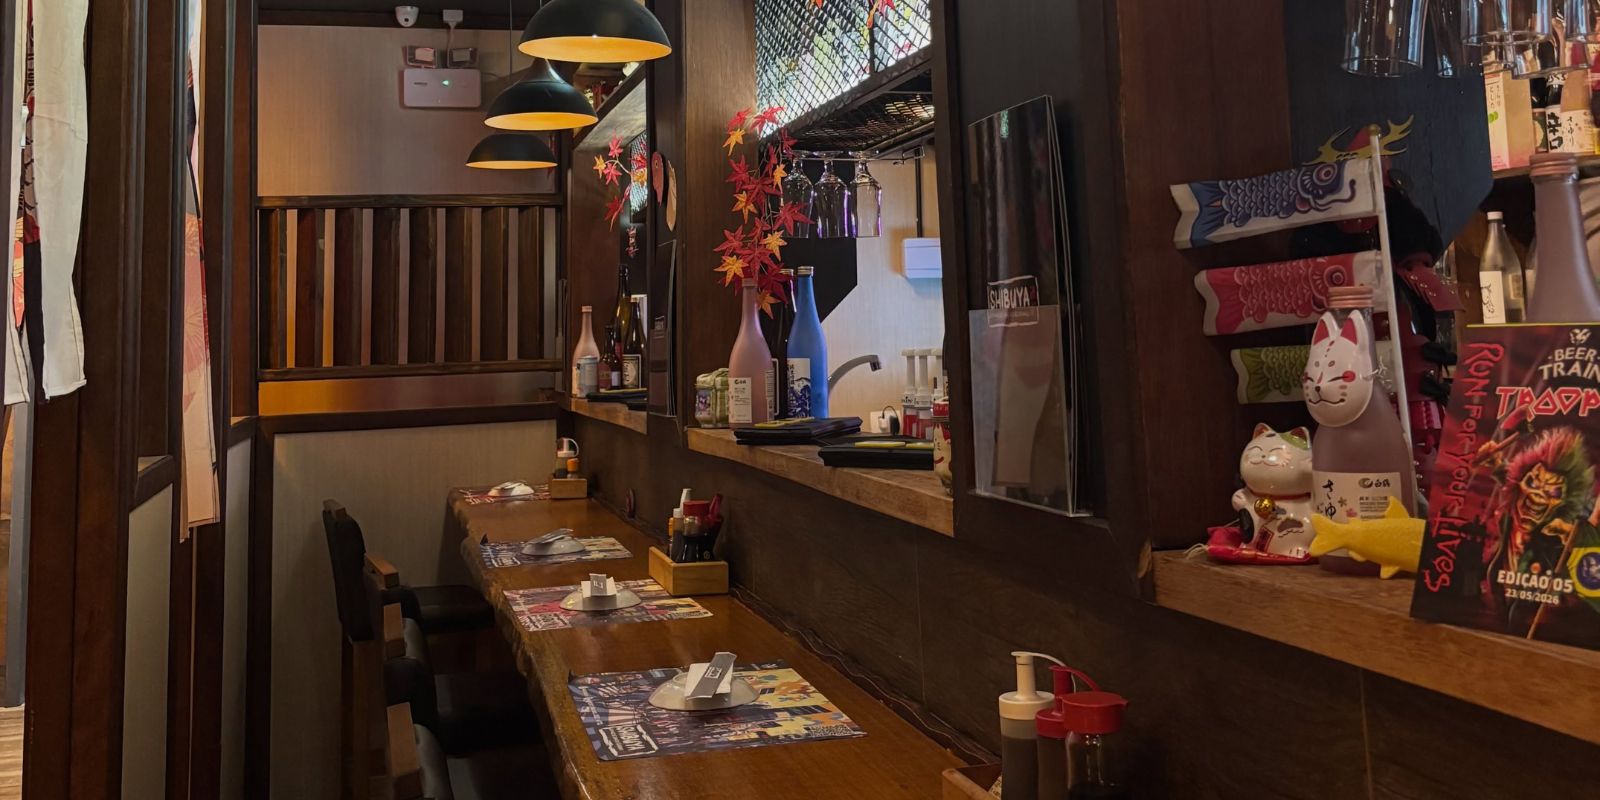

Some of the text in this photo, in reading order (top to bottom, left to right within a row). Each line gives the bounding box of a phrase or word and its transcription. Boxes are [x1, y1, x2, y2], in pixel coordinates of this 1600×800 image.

[990, 286, 1030, 310] SHIBUYA
[1463, 343, 1505, 397] RUN
[1552, 577, 1574, 593] 05
[1505, 588, 1560, 605] 23/05/2026
